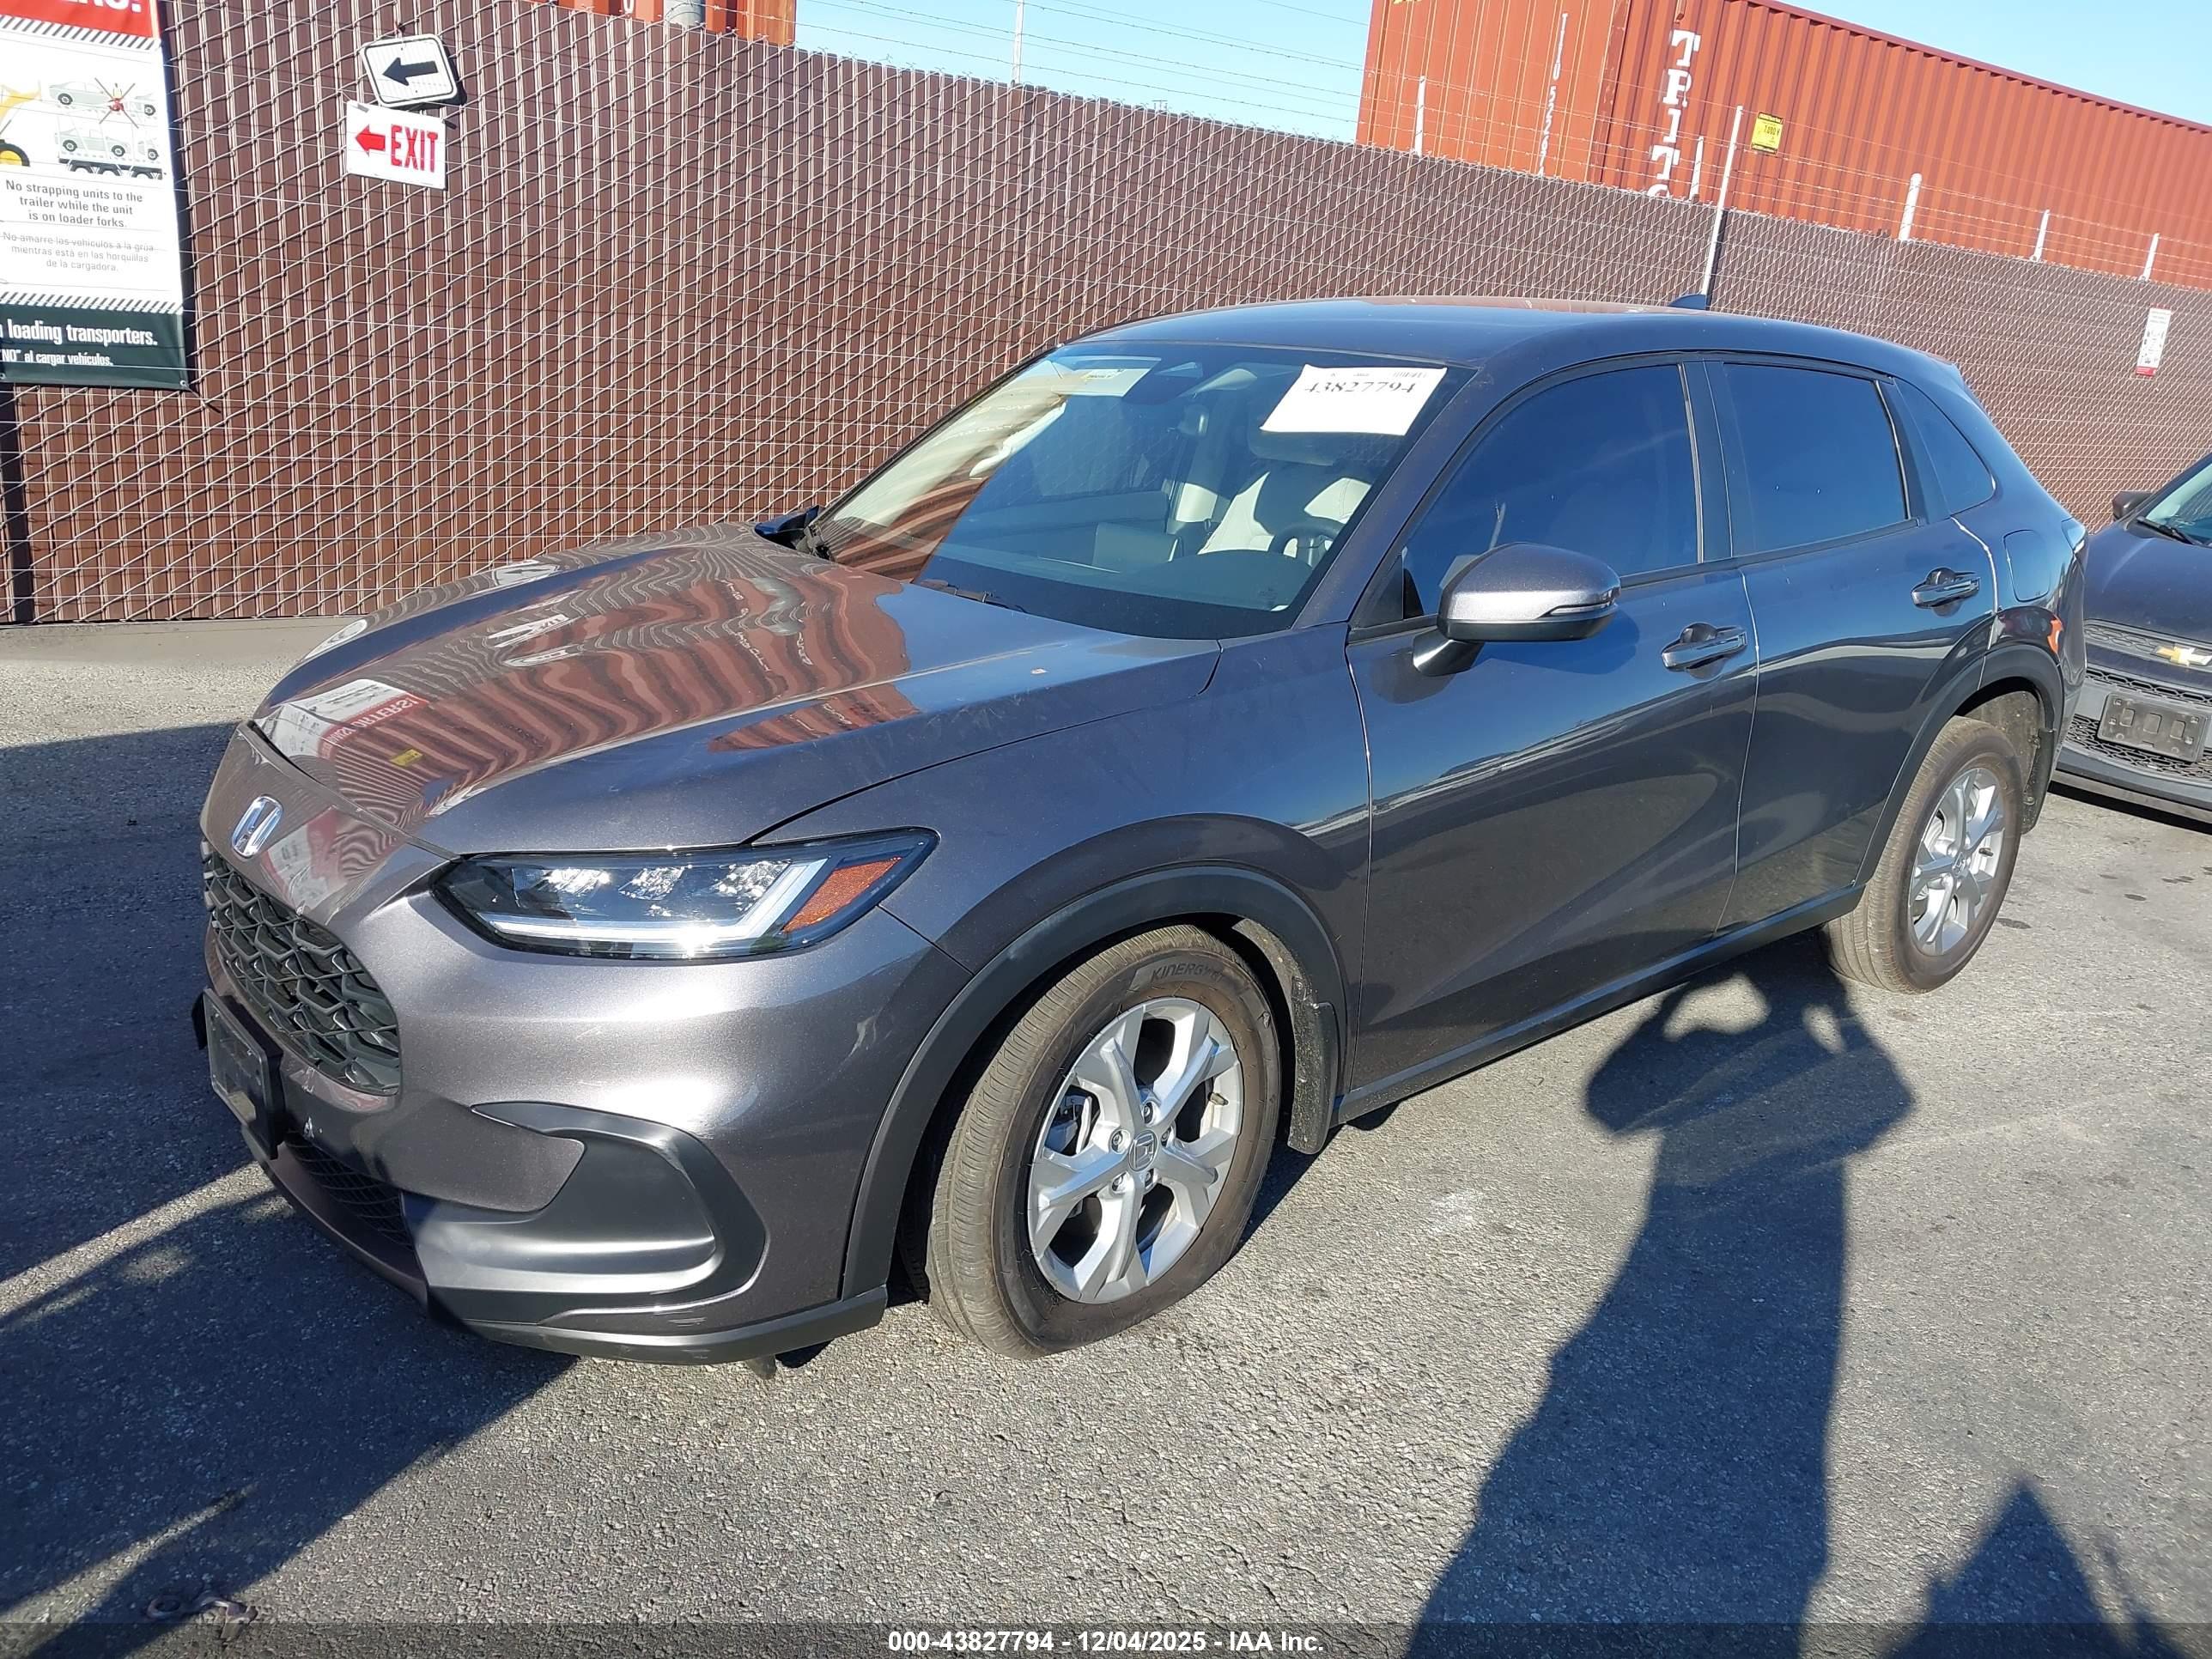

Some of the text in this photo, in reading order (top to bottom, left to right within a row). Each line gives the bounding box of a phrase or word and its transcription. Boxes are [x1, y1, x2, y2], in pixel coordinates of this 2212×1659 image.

[391, 124, 438, 173] EXIT
[6, 179, 22, 191] No
[27, 183, 80, 198] strapping
[83, 189, 110, 199] units
[126, 191, 143, 202] the
[20, 197, 133, 215] trailer while the unit
[28, 210, 127, 228] is on loader forks.
[3, 232, 17, 241] No
[21, 234, 53, 244] amarre
[56, 236, 70, 245] los
[124, 240, 131, 250] la
[11, 246, 52, 255] mientras
[91, 250, 104, 259] las
[106, 252, 149, 263] horquillas
[46, 258, 57, 267] de
[60, 258, 68, 268] la
[8, 319, 63, 345] loading
[66, 324, 158, 347] transporters.
[24, 350, 33, 362] al
[36, 353, 65, 366] cargar
[68, 351, 113, 366] vehículos.
[1305, 381, 1416, 393] 43827794
